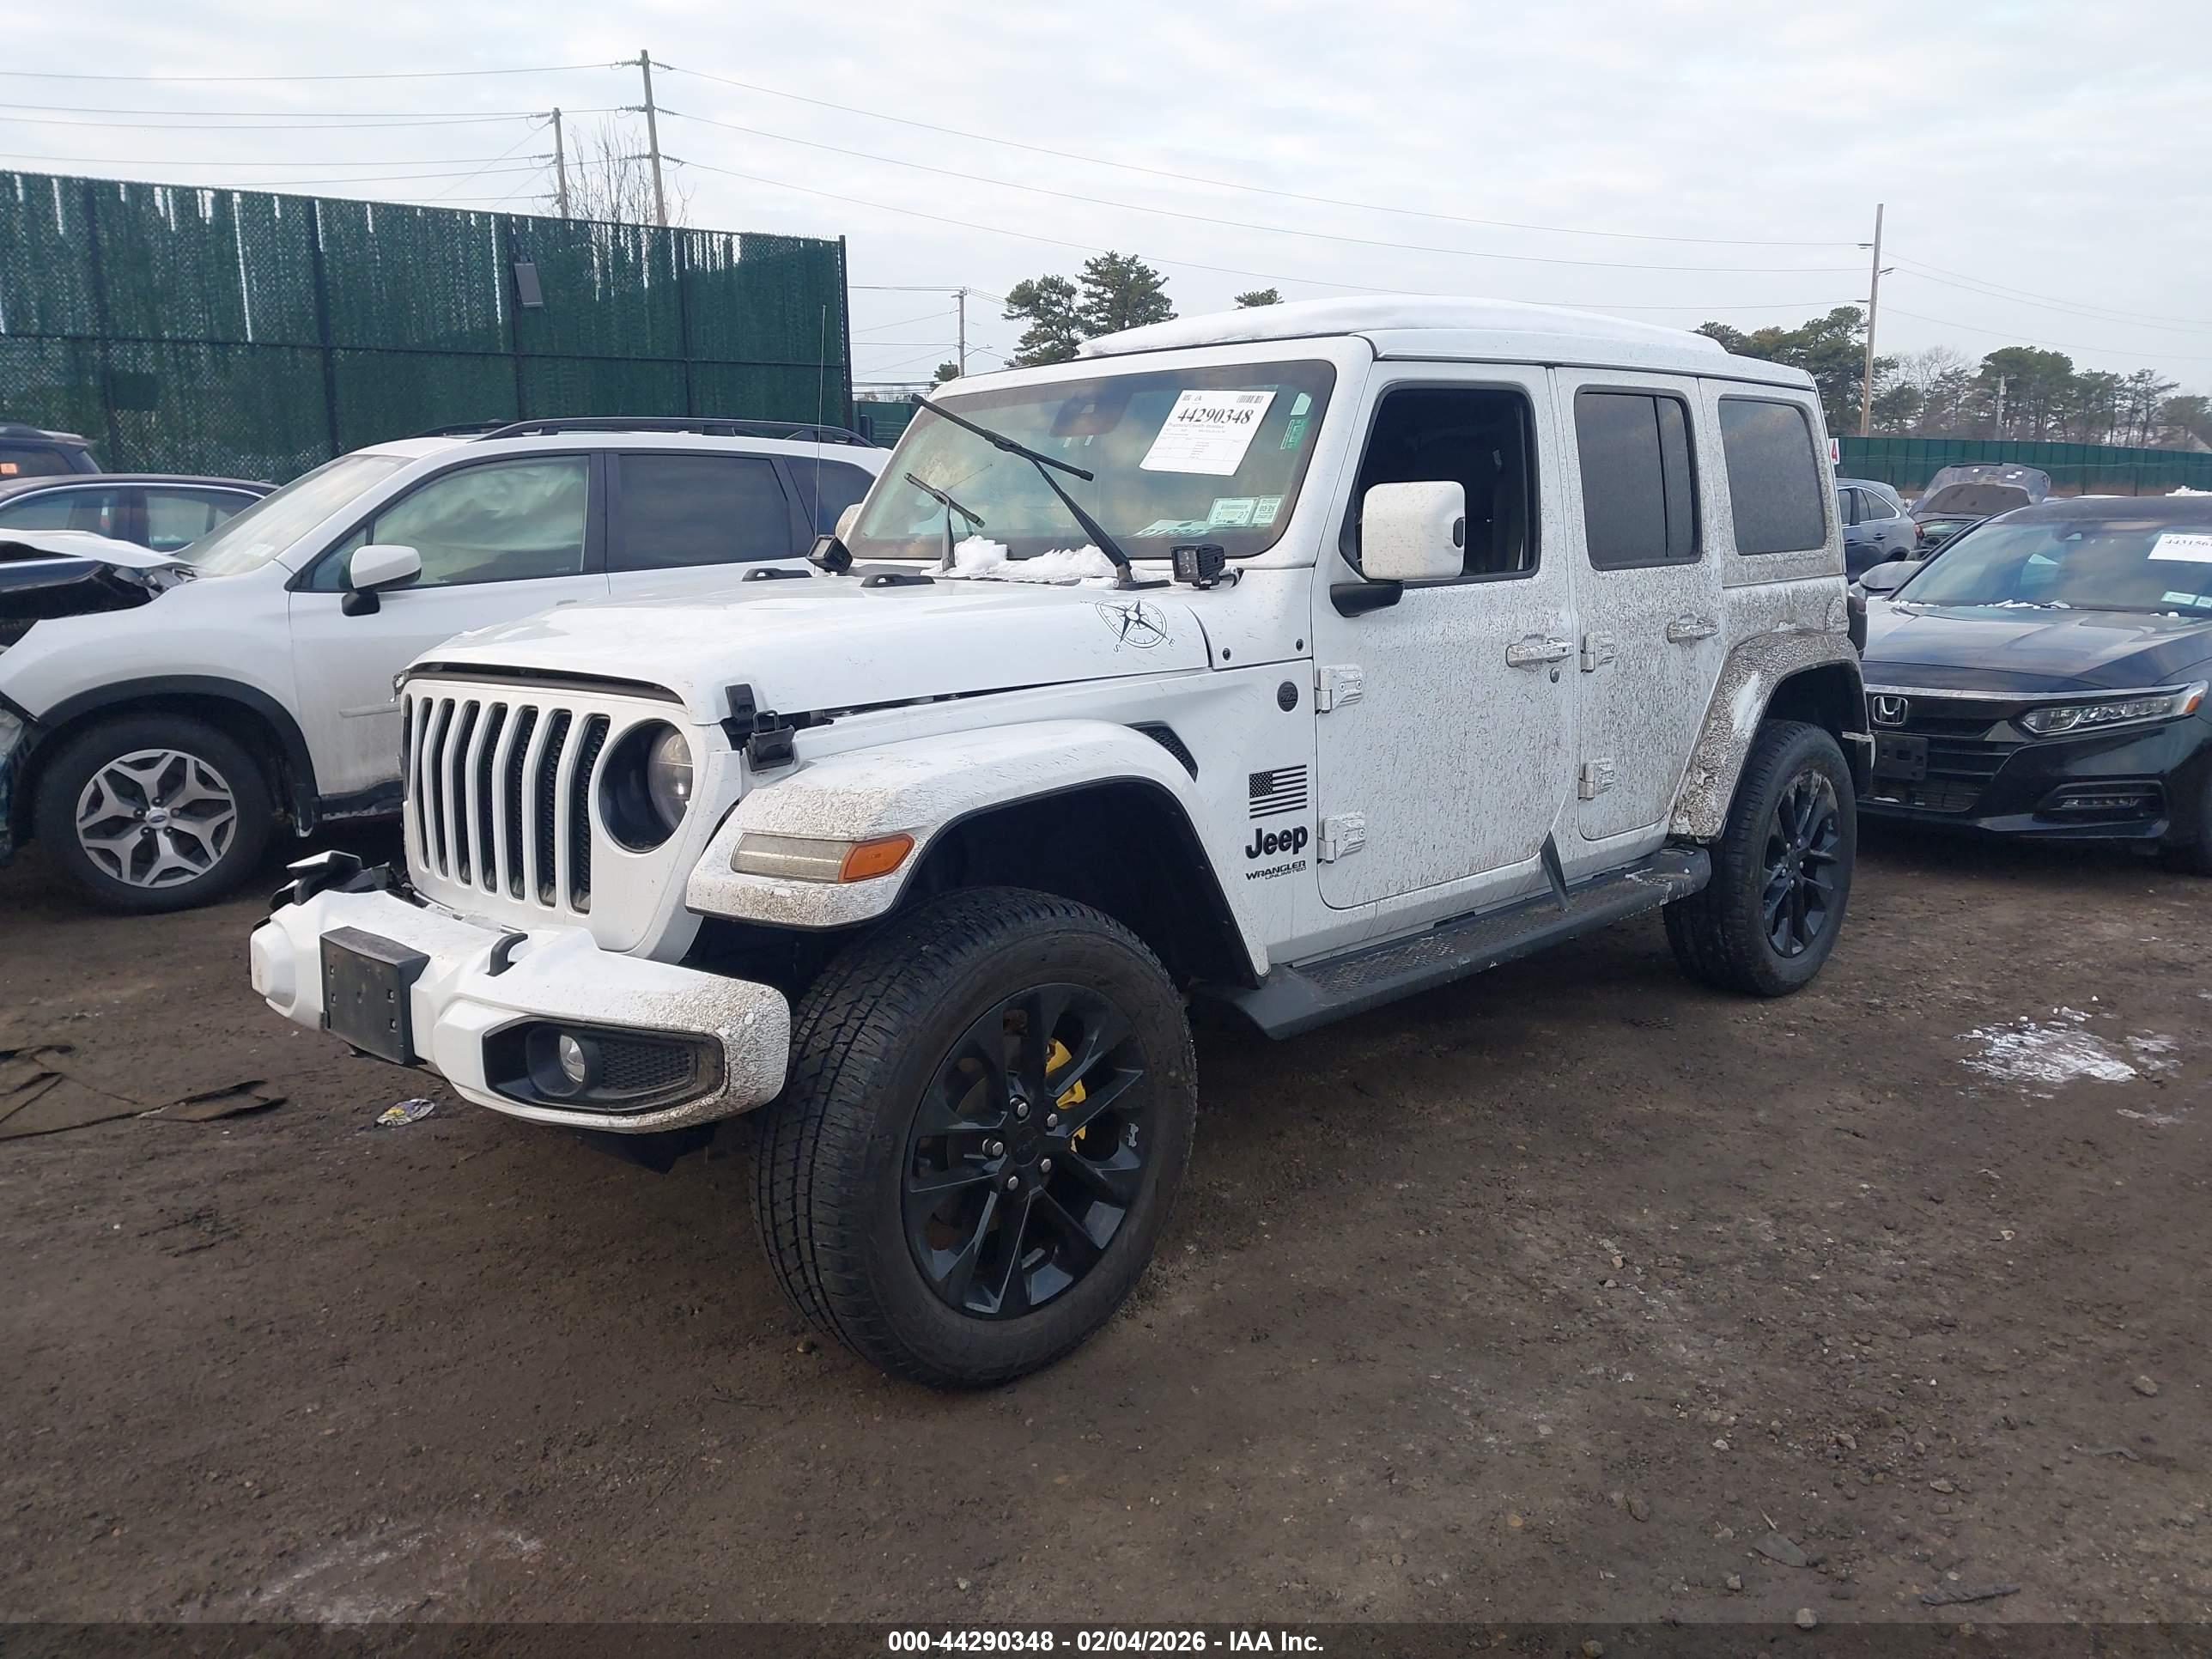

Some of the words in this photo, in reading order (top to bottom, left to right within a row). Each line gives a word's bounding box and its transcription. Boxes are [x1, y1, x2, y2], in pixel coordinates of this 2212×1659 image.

[1177, 408, 1254, 424] 44290348
[1245, 826, 1308, 859] Jeep
[1245, 860, 1306, 880] WRANGLER
